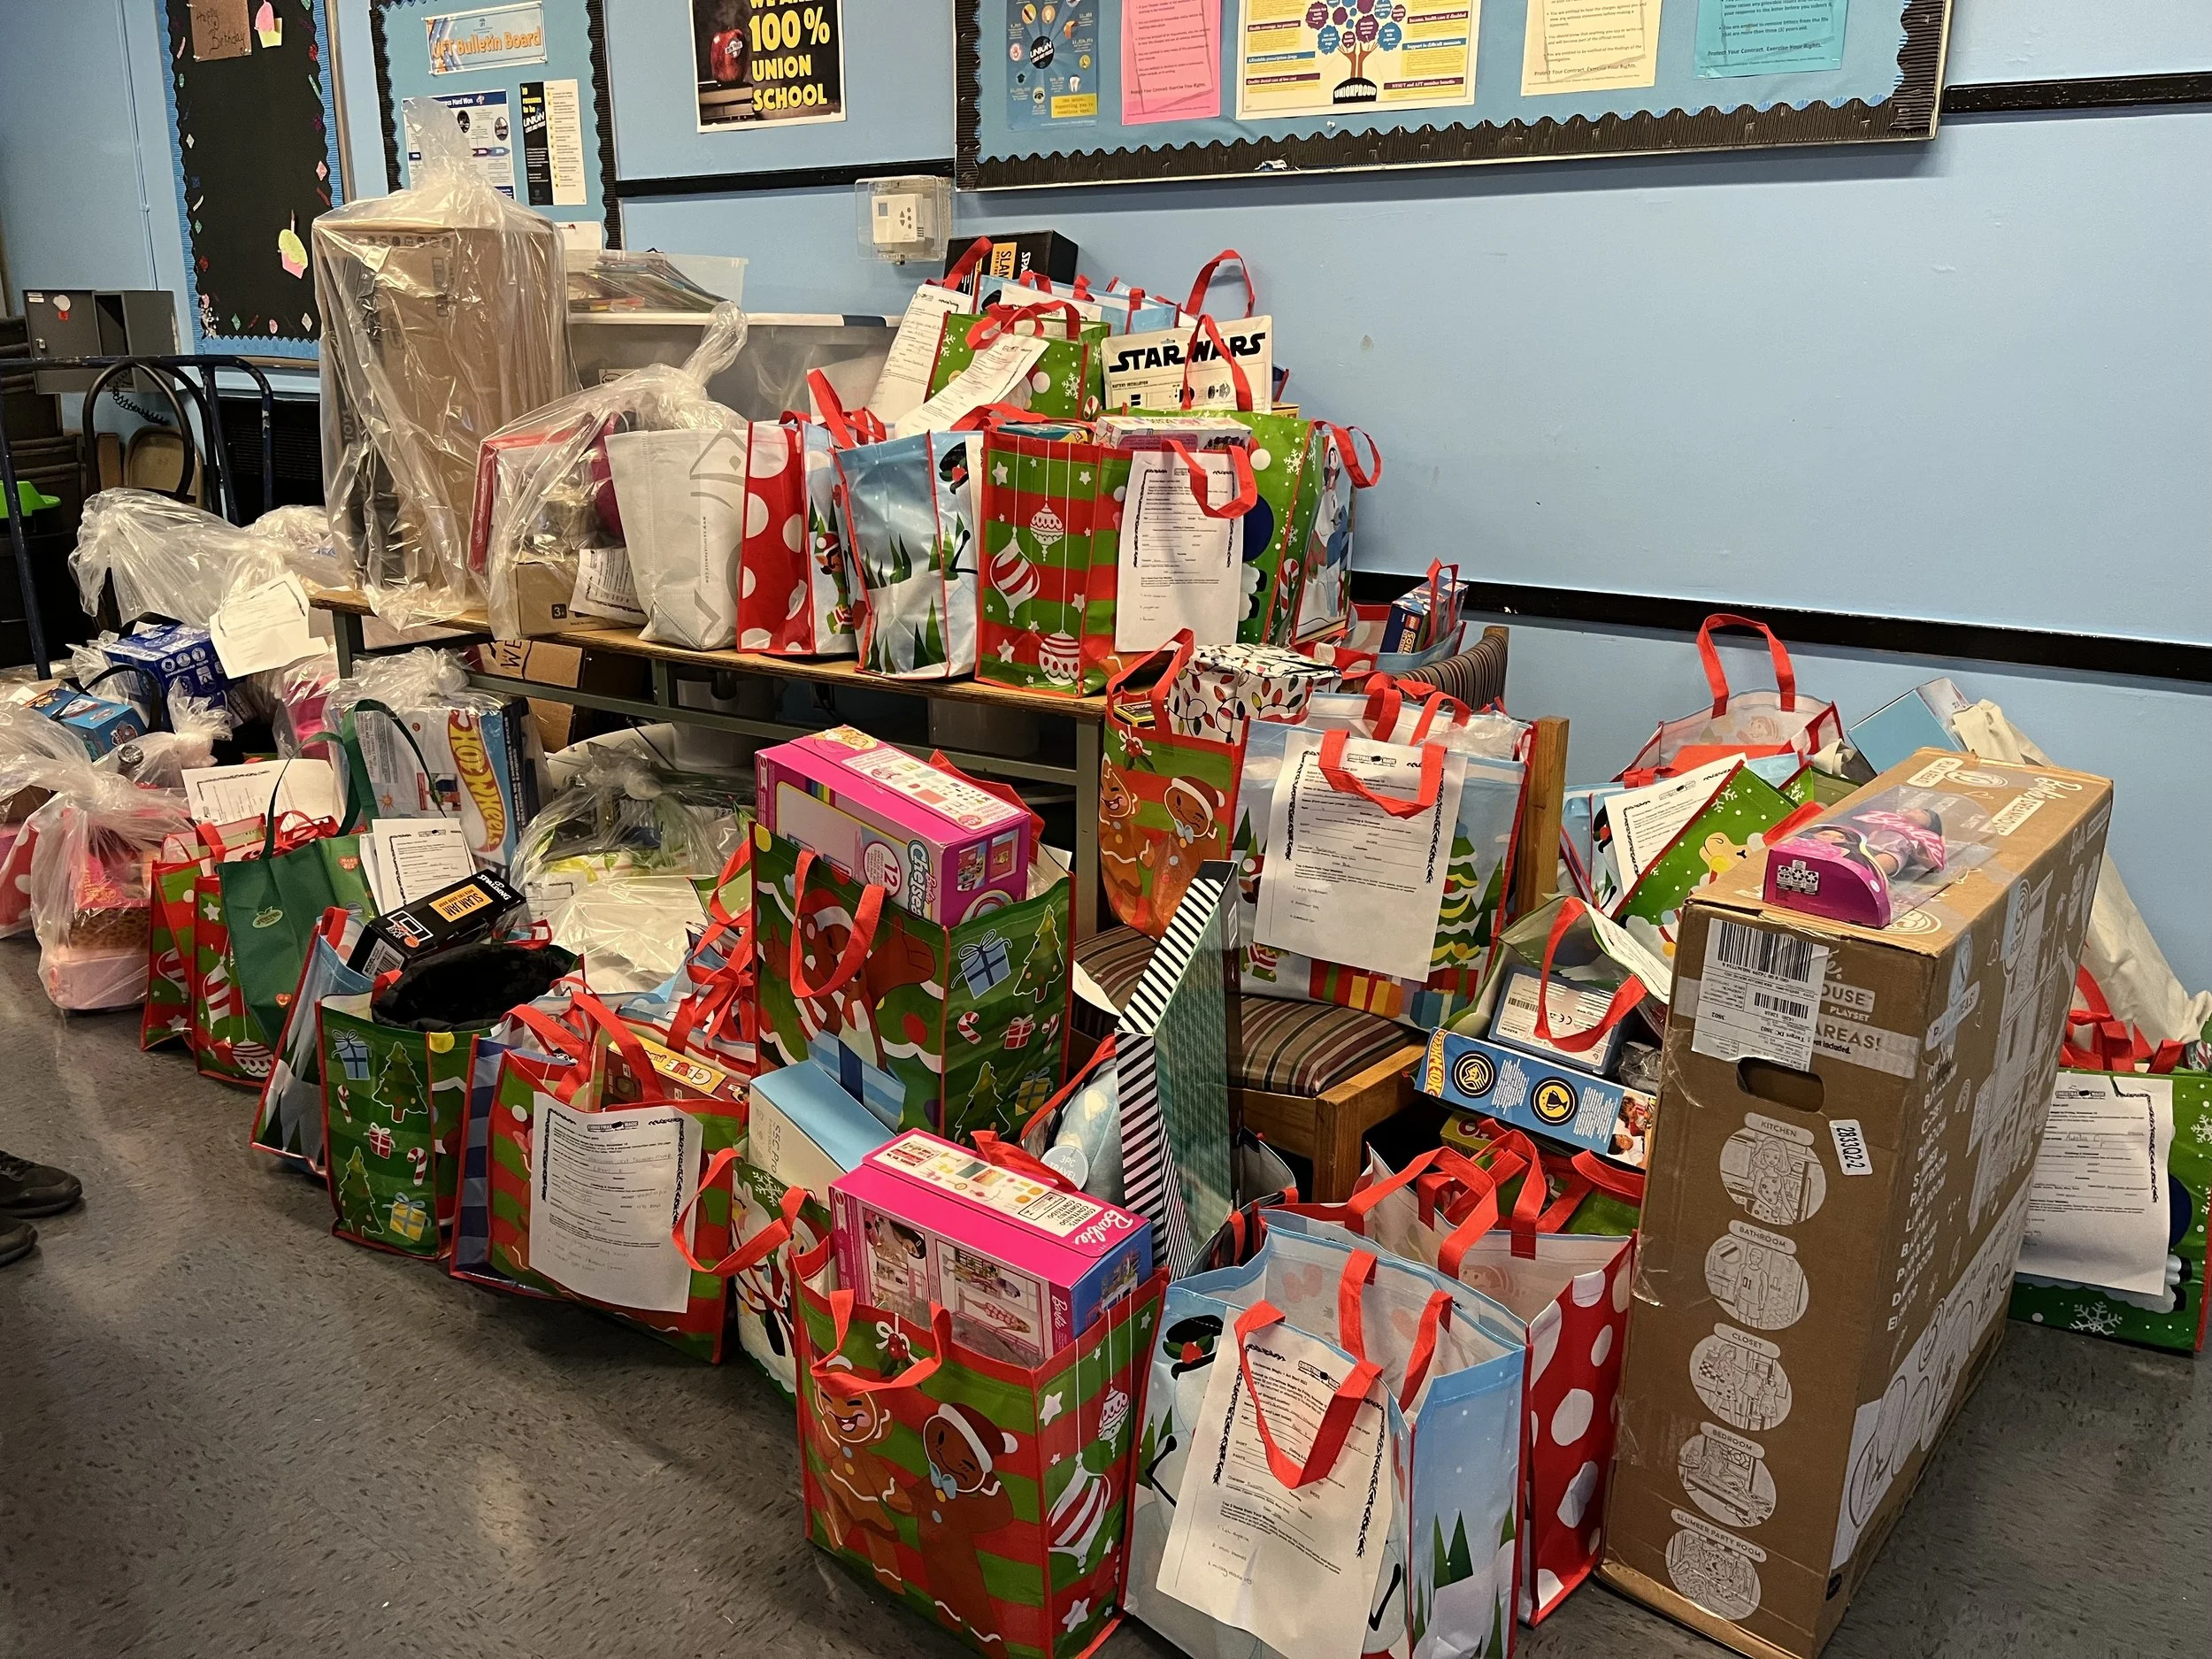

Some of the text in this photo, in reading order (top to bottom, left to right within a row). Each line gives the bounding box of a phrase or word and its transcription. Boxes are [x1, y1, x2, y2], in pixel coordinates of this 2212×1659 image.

[749, 6, 830, 51] 100%
[433, 27, 541, 58] UFT Bulletin Board
[1030, 42, 1053, 58] UNION
[752, 54, 812, 81] UNION
[753, 83, 827, 111] SCHOOL
[1334, 84, 1376, 98] UNIONPROUD
[523, 111, 545, 127] UNION
[1109, 332, 1266, 373] STAR WARS
[477, 873, 512, 901] SPALDING
[910, 843, 929, 916] Chelsea
[442, 892, 484, 917] SLAM JAM
[1830, 1005, 1870, 1022] PLAYSET
[1787, 1033, 1805, 1042] Target
[1816, 1024, 1880, 1051] AREAS!
[1822, 1041, 1851, 1055] included.
[664, 1060, 711, 1085] CLUE
[1761, 1120, 1798, 1138] KITCHEN
[1049, 1161, 1077, 1182] TRAVEL
[1060, 1155, 1076, 1167] 3PC
[1074, 1209, 1133, 1245] Barbie
[1739, 1226, 1786, 1248] BATHROOM
[1051, 1294, 1068, 1330] Barbie
[1732, 1333, 1763, 1350] CLOSET
[1712, 1429, 1753, 1450] BEDROOM
[1677, 1512, 1761, 1557] SLUMBER PARTY ROOM
